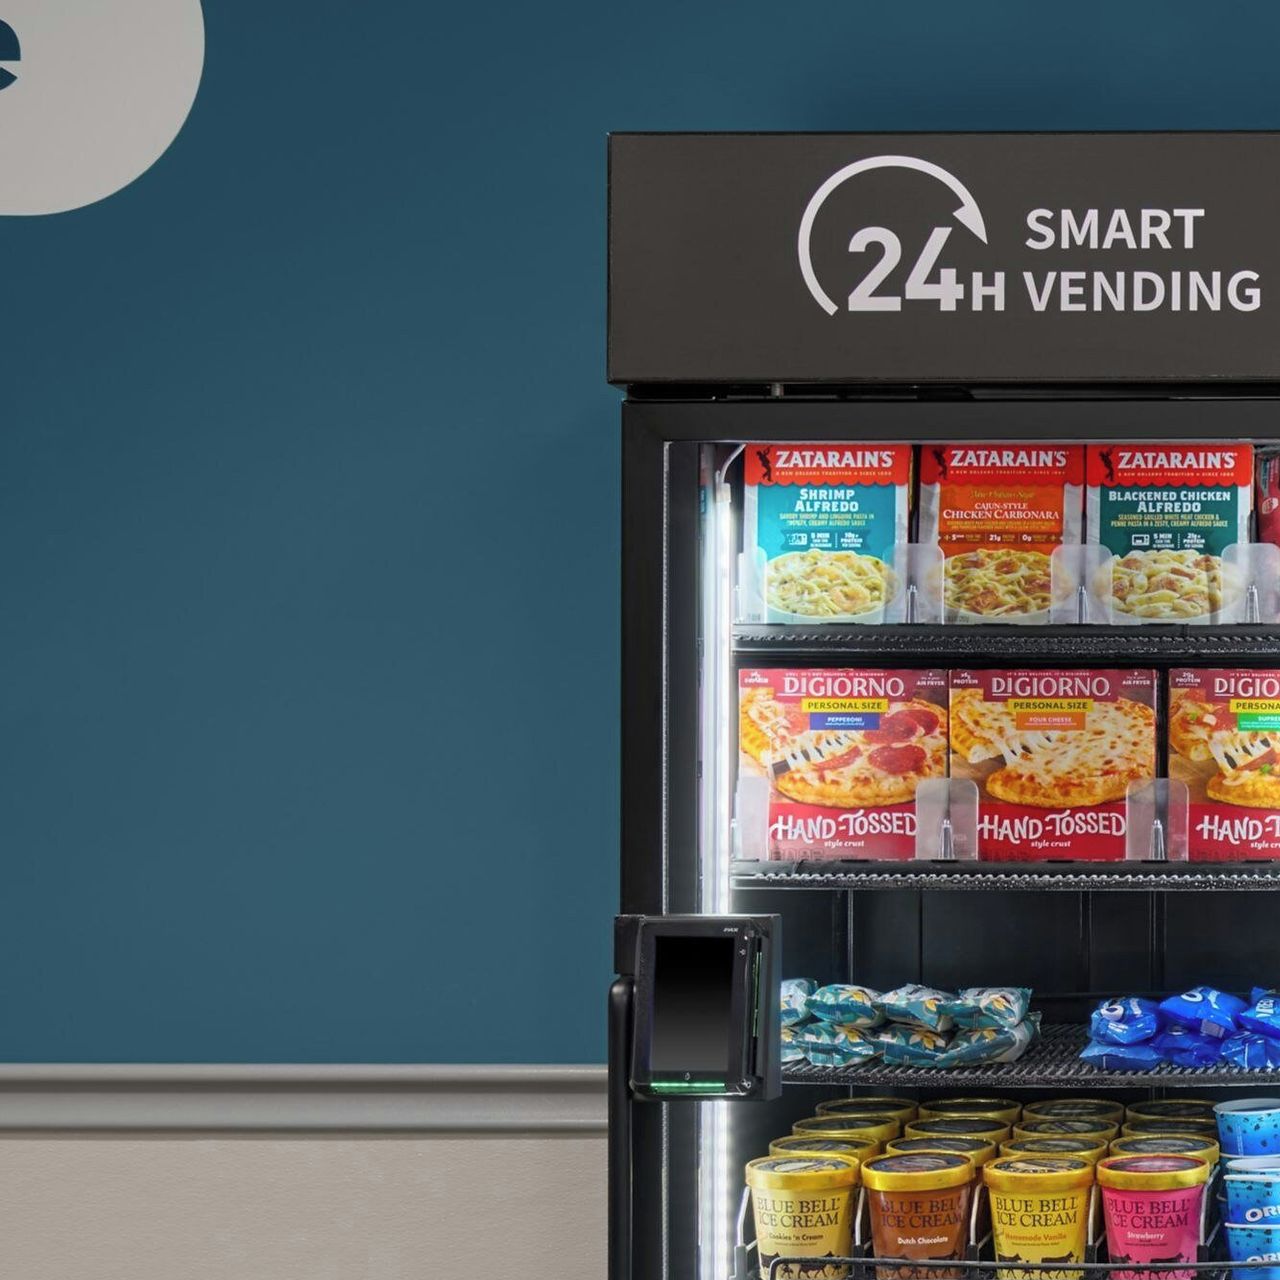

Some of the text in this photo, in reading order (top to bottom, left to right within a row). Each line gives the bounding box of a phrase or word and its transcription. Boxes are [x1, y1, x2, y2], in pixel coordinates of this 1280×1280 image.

[1025, 208, 1205, 250] SMART
[1023, 270, 1261, 311] VENDING
[776, 451, 893, 468] ZATARAIN'S
[950, 450, 1067, 467] ZATARAIN'S
[1118, 452, 1235, 468] ZATARAIN'S
[800, 488, 855, 500] SHRIMP
[1109, 491, 1231, 501] BLACKENED CHICKEN
[795, 501, 858, 512] ALFREDO
[943, 509, 1059, 519] CHICKEN CARBONARA
[975, 502, 1028, 510] CAJUN-STYLE
[1137, 502, 1201, 512] ALFREDO
[992, 677, 1111, 697] DIGIORNO
[808, 701, 882, 710] PERSONAL SIZE
[1014, 701, 1088, 709] PERSONAL SIZE
[770, 809, 916, 844] HAND-TOSSED
[978, 809, 1126, 844] HAND-TOSSED
[757, 1197, 838, 1214] BLUE BELL
[996, 1197, 1078, 1213] BLUE BELL
[759, 1214, 838, 1228] ICE CREAM
[997, 1212, 1077, 1228] ICE CREAM
[1127, 1232, 1165, 1242] Strawberry
